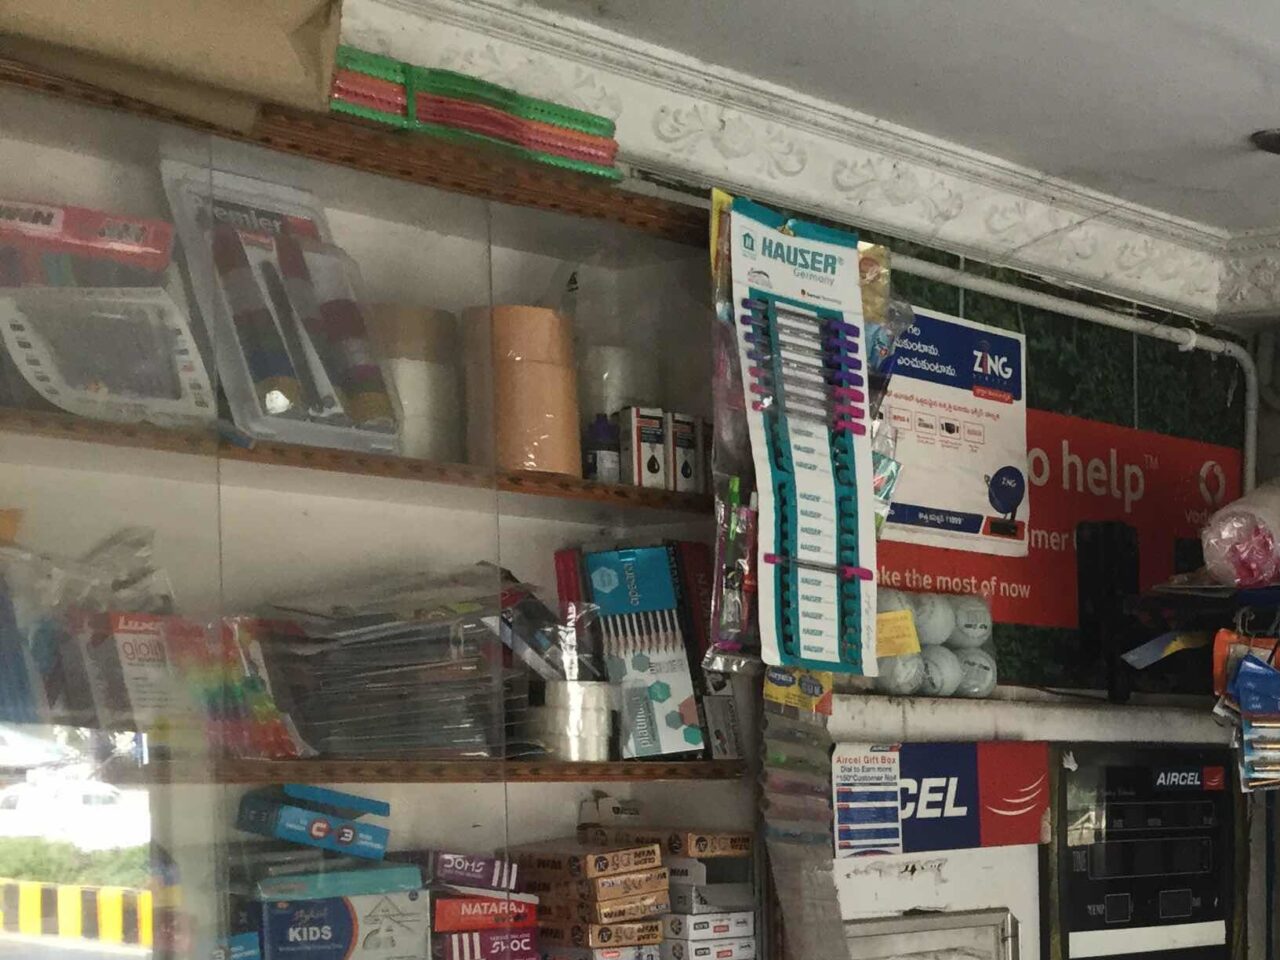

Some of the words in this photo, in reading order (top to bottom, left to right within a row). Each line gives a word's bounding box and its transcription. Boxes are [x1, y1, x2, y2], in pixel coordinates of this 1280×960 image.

[761, 236, 838, 275] HAUSER
[793, 267, 835, 286] Germany
[973, 350, 1013, 379] ZING
[1027, 446, 1050, 487] o
[1062, 439, 1145, 513] help
[1030, 528, 1070, 550] mer
[876, 566, 901, 587] ake
[904, 566, 932, 588] the
[936, 573, 979, 595] most
[981, 574, 997, 597] of
[1000, 580, 1031, 599] now
[836, 755, 861, 765] Aircel
[863, 755, 879, 765] Gift
[881, 755, 896, 765] Box
[1156, 771, 1201, 786] AIRCEL
[900, 776, 969, 820] CEL
[461, 901, 526, 915] NATARAJ
[289, 926, 333, 942] KIDS
